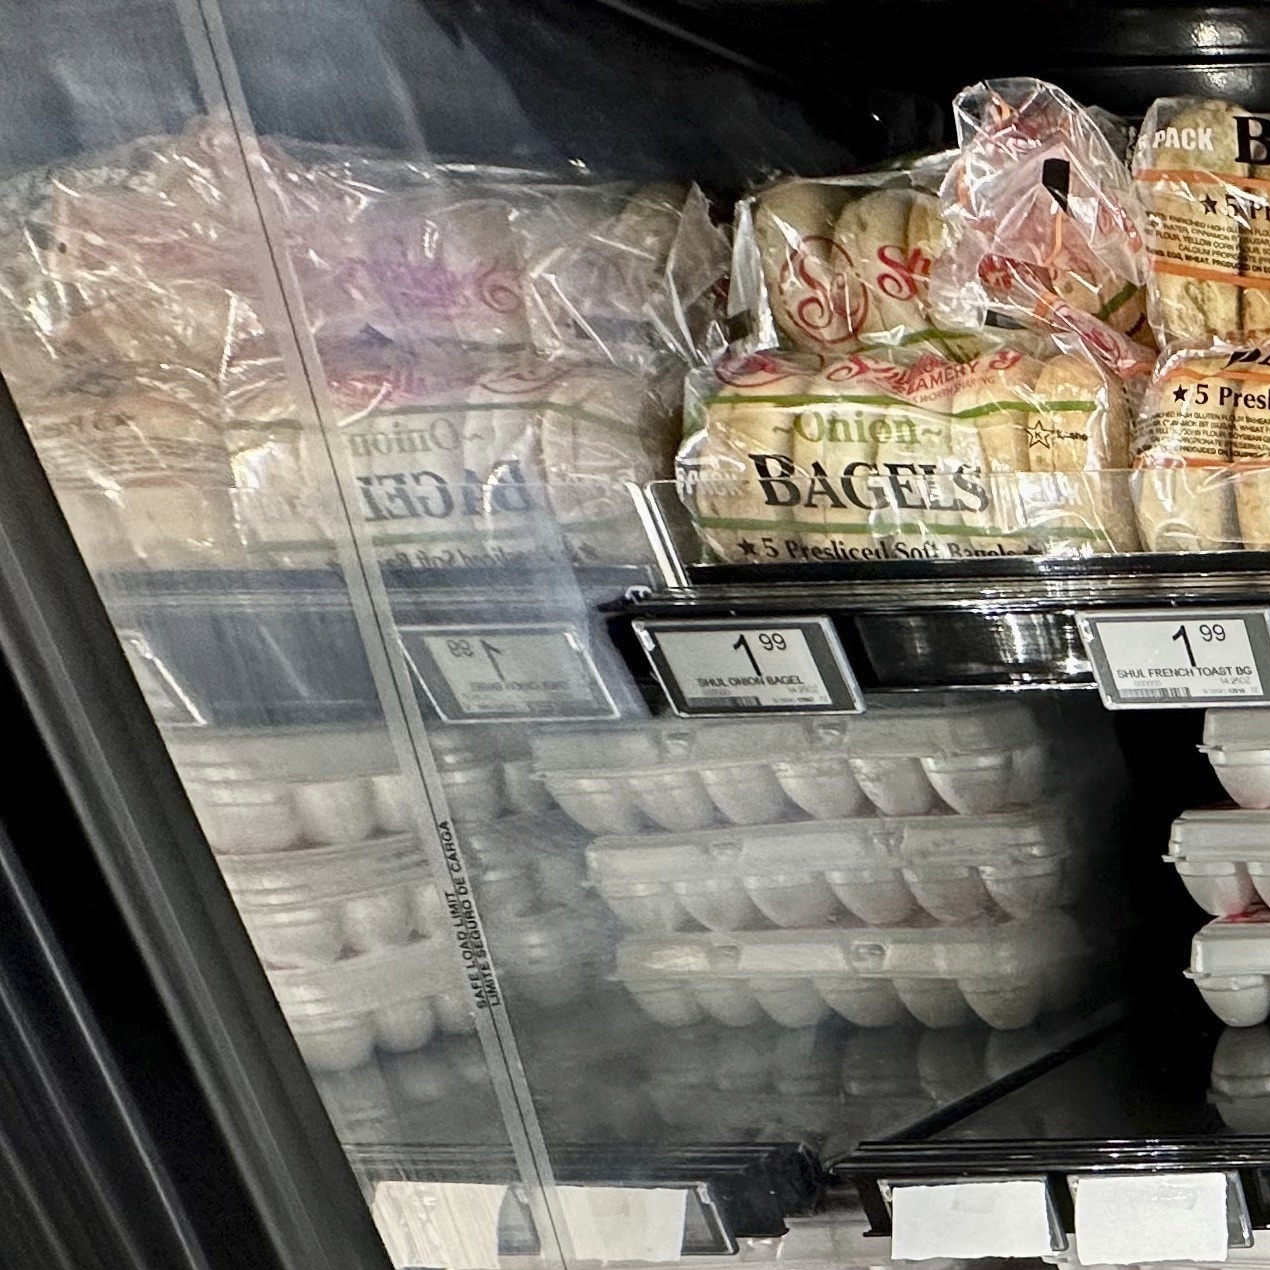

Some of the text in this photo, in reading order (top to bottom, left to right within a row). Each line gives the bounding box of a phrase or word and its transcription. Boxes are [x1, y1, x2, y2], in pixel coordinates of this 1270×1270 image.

[1194, 386, 1209, 405] 5
[795, 410, 919, 445] Onion
[749, 453, 988, 513] BAGELS
[788, 540, 937, 562] Presliced Soft
[733, 633, 787, 676] 1 99
[1172, 624, 1226, 667] 1 99
[697, 675, 805, 688] SHUL ONION BAGEL
[1117, 666, 1232, 679] SHUL FRENCH TOAST
[439, 820, 501, 1007] LIMITE DE CARGA
[444, 890, 488, 1010] SAFE LOAD LIMIT
